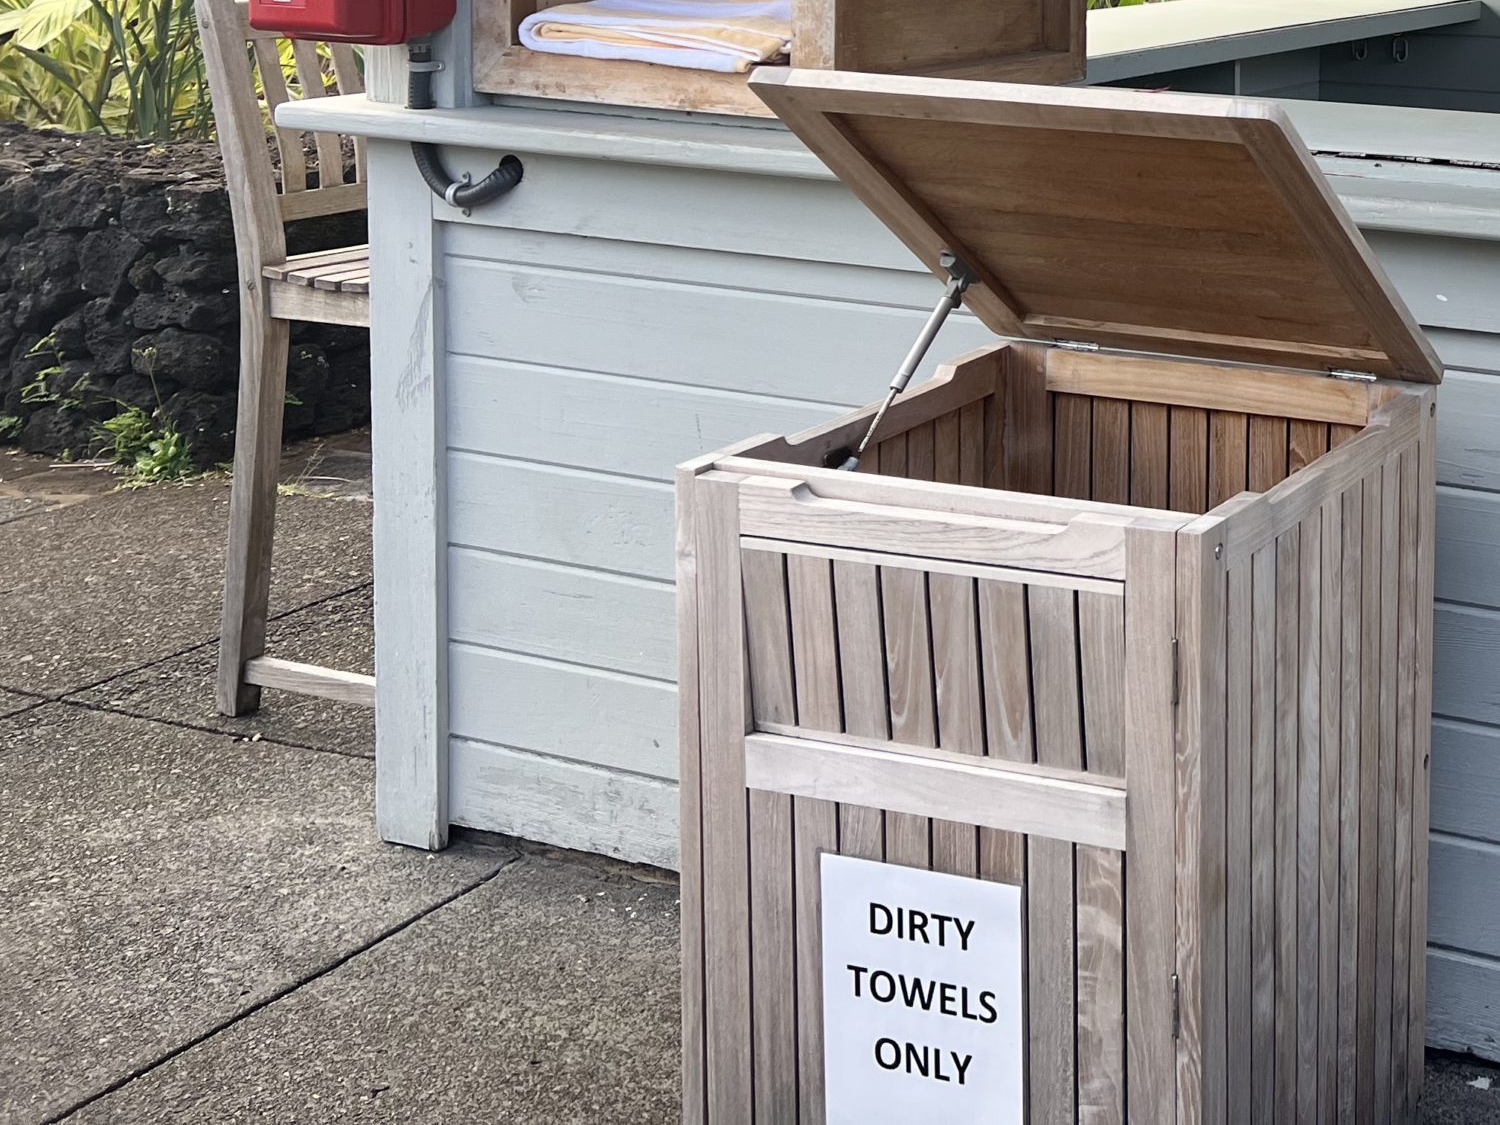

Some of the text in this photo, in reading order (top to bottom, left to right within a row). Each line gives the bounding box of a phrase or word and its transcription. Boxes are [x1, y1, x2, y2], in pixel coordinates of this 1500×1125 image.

[869, 902, 975, 951] DIRTY
[847, 964, 997, 1024] TOWELS
[874, 1037, 973, 1085] ONLY
